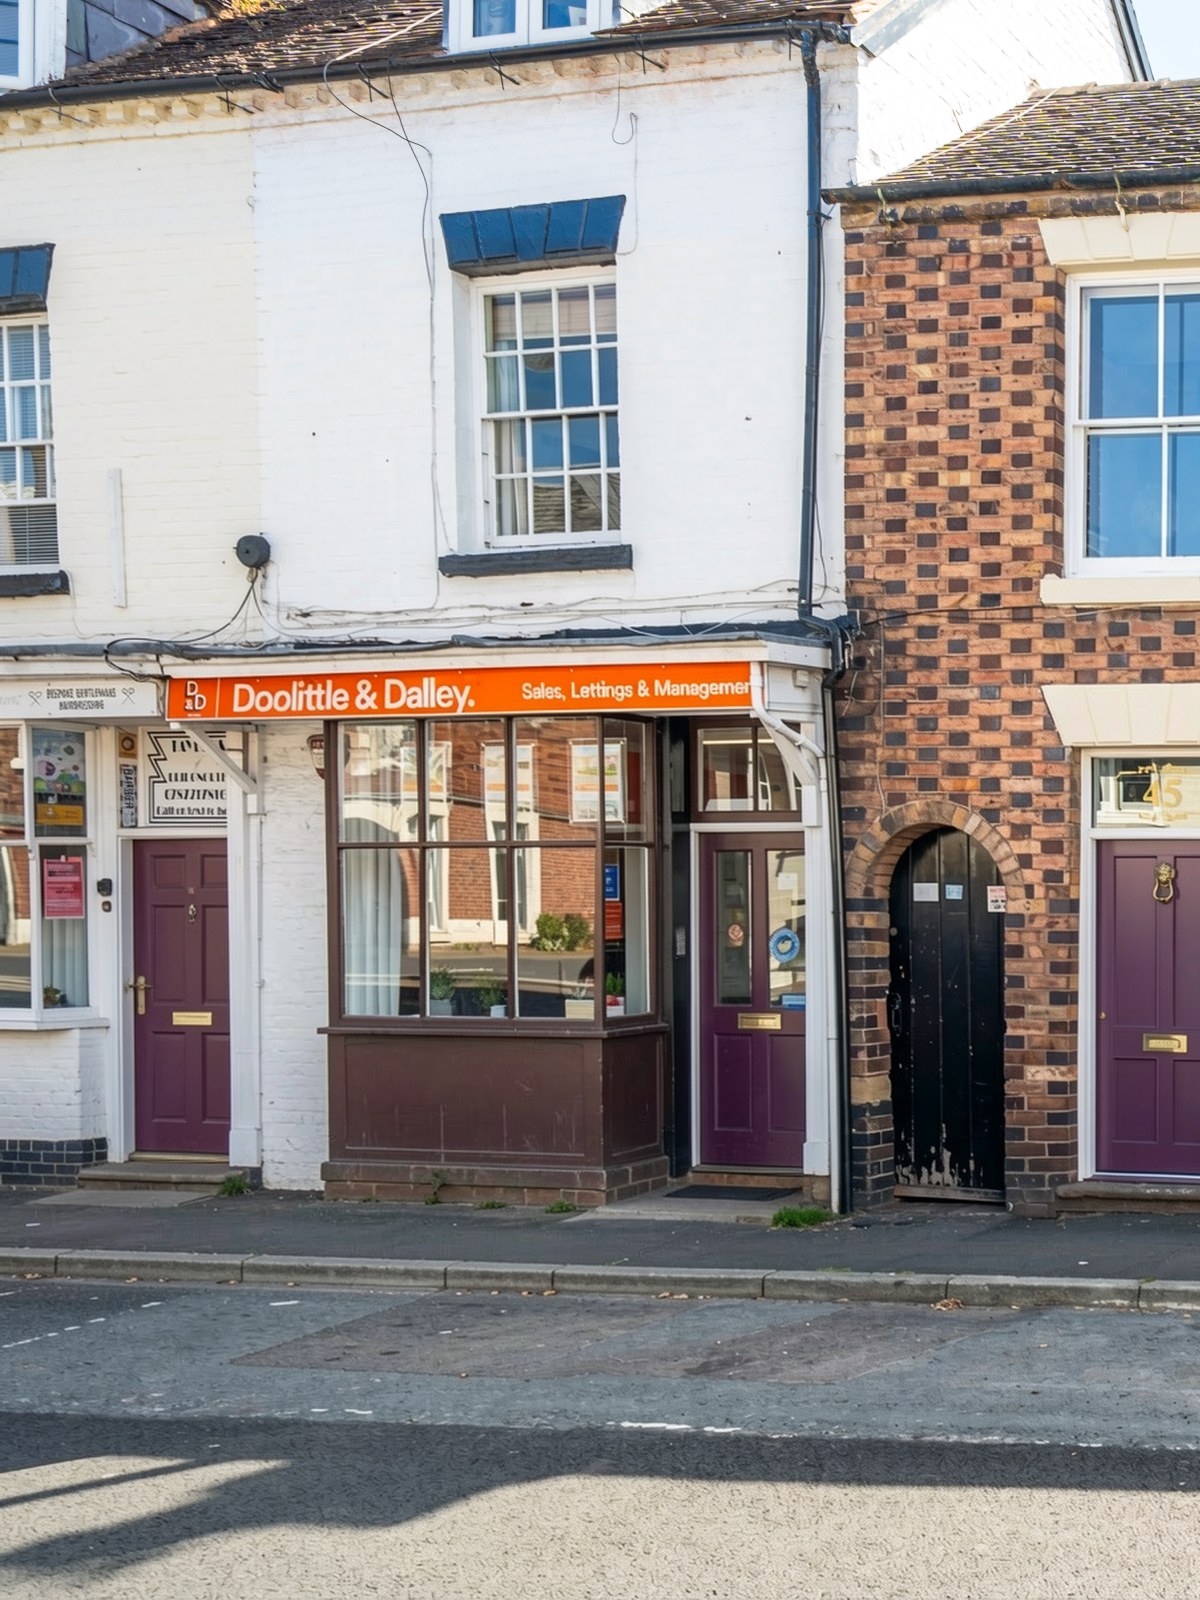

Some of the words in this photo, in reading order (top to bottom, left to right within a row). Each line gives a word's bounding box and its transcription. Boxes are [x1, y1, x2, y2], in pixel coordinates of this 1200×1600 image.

[232, 680, 350, 713] Doolittle
[355, 678, 379, 711] &
[384, 677, 476, 714] Dalley.
[521, 682, 566, 701] Sales,
[571, 680, 633, 702] Lettings
[637, 679, 650, 697] &
[1142, 778, 1184, 809] 45
